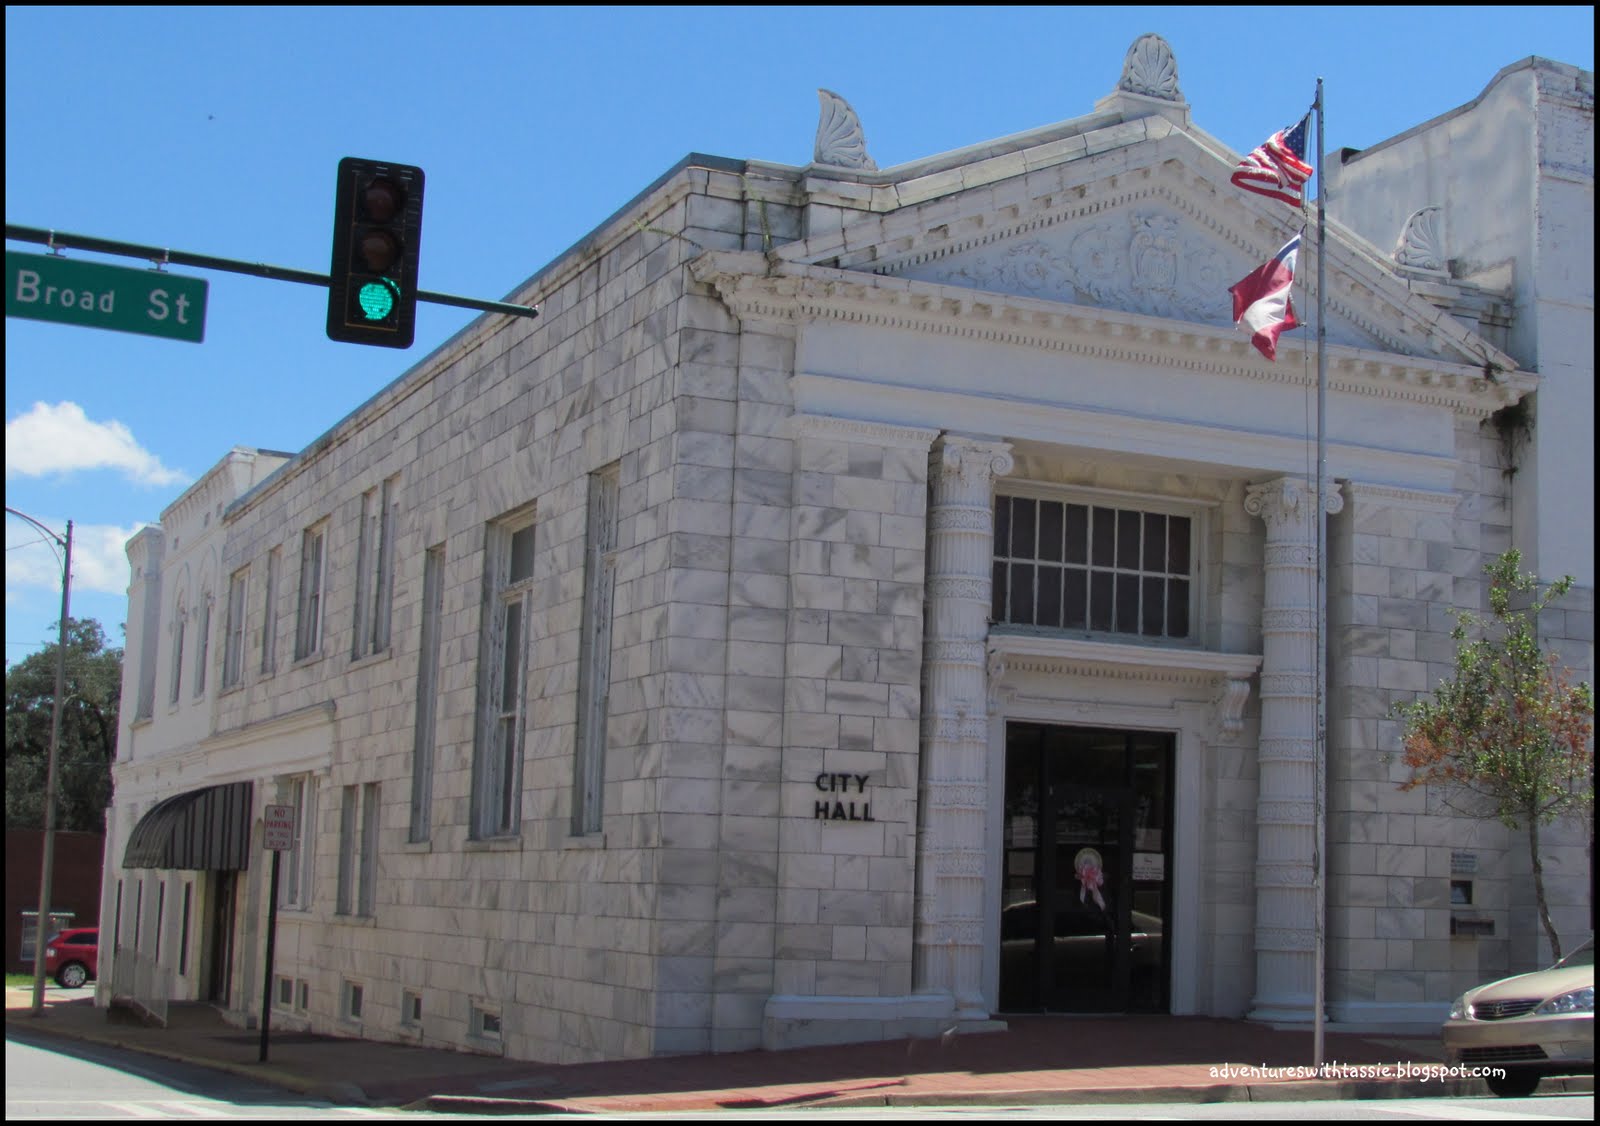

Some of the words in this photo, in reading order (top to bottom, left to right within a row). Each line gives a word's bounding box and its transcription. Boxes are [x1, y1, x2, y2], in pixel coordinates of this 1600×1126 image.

[16, 269, 115, 313] Broad
[147, 288, 190, 324] St
[815, 773, 869, 793] CITY
[274, 809, 286, 818] NO
[815, 801, 875, 822] HALL
[266, 821, 291, 830] PARKING
